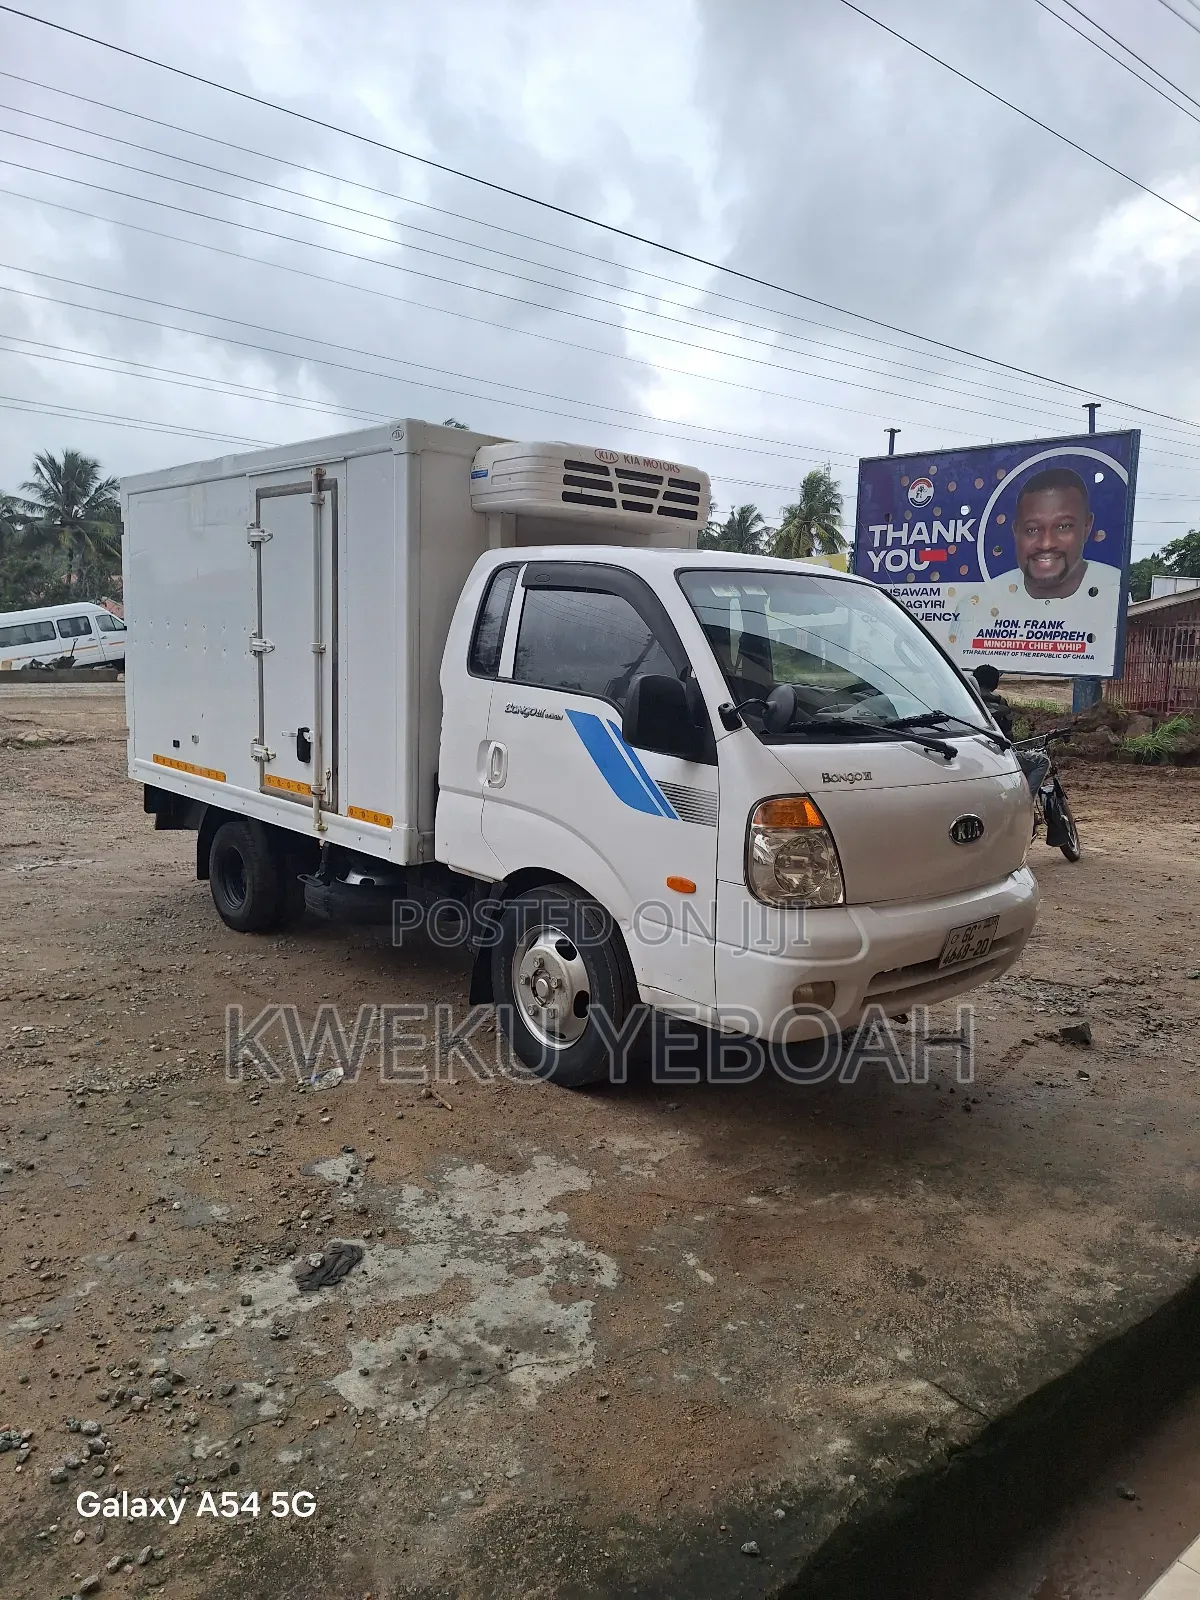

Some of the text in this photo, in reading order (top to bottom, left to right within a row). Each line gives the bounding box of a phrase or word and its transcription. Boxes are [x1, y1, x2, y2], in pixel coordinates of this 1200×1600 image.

[623, 454, 680, 473] KIA MOTORS
[868, 518, 977, 547] THANK
[867, 547, 932, 573] YOU
[901, 600, 945, 609] AGYIRI
[994, 619, 1066, 630] HON. FRANK
[976, 629, 1018, 639] ANNOH
[1025, 630, 1086, 642] DOMPREH
[983, 639, 1082, 652] MINORITY CHIEF WHIP
